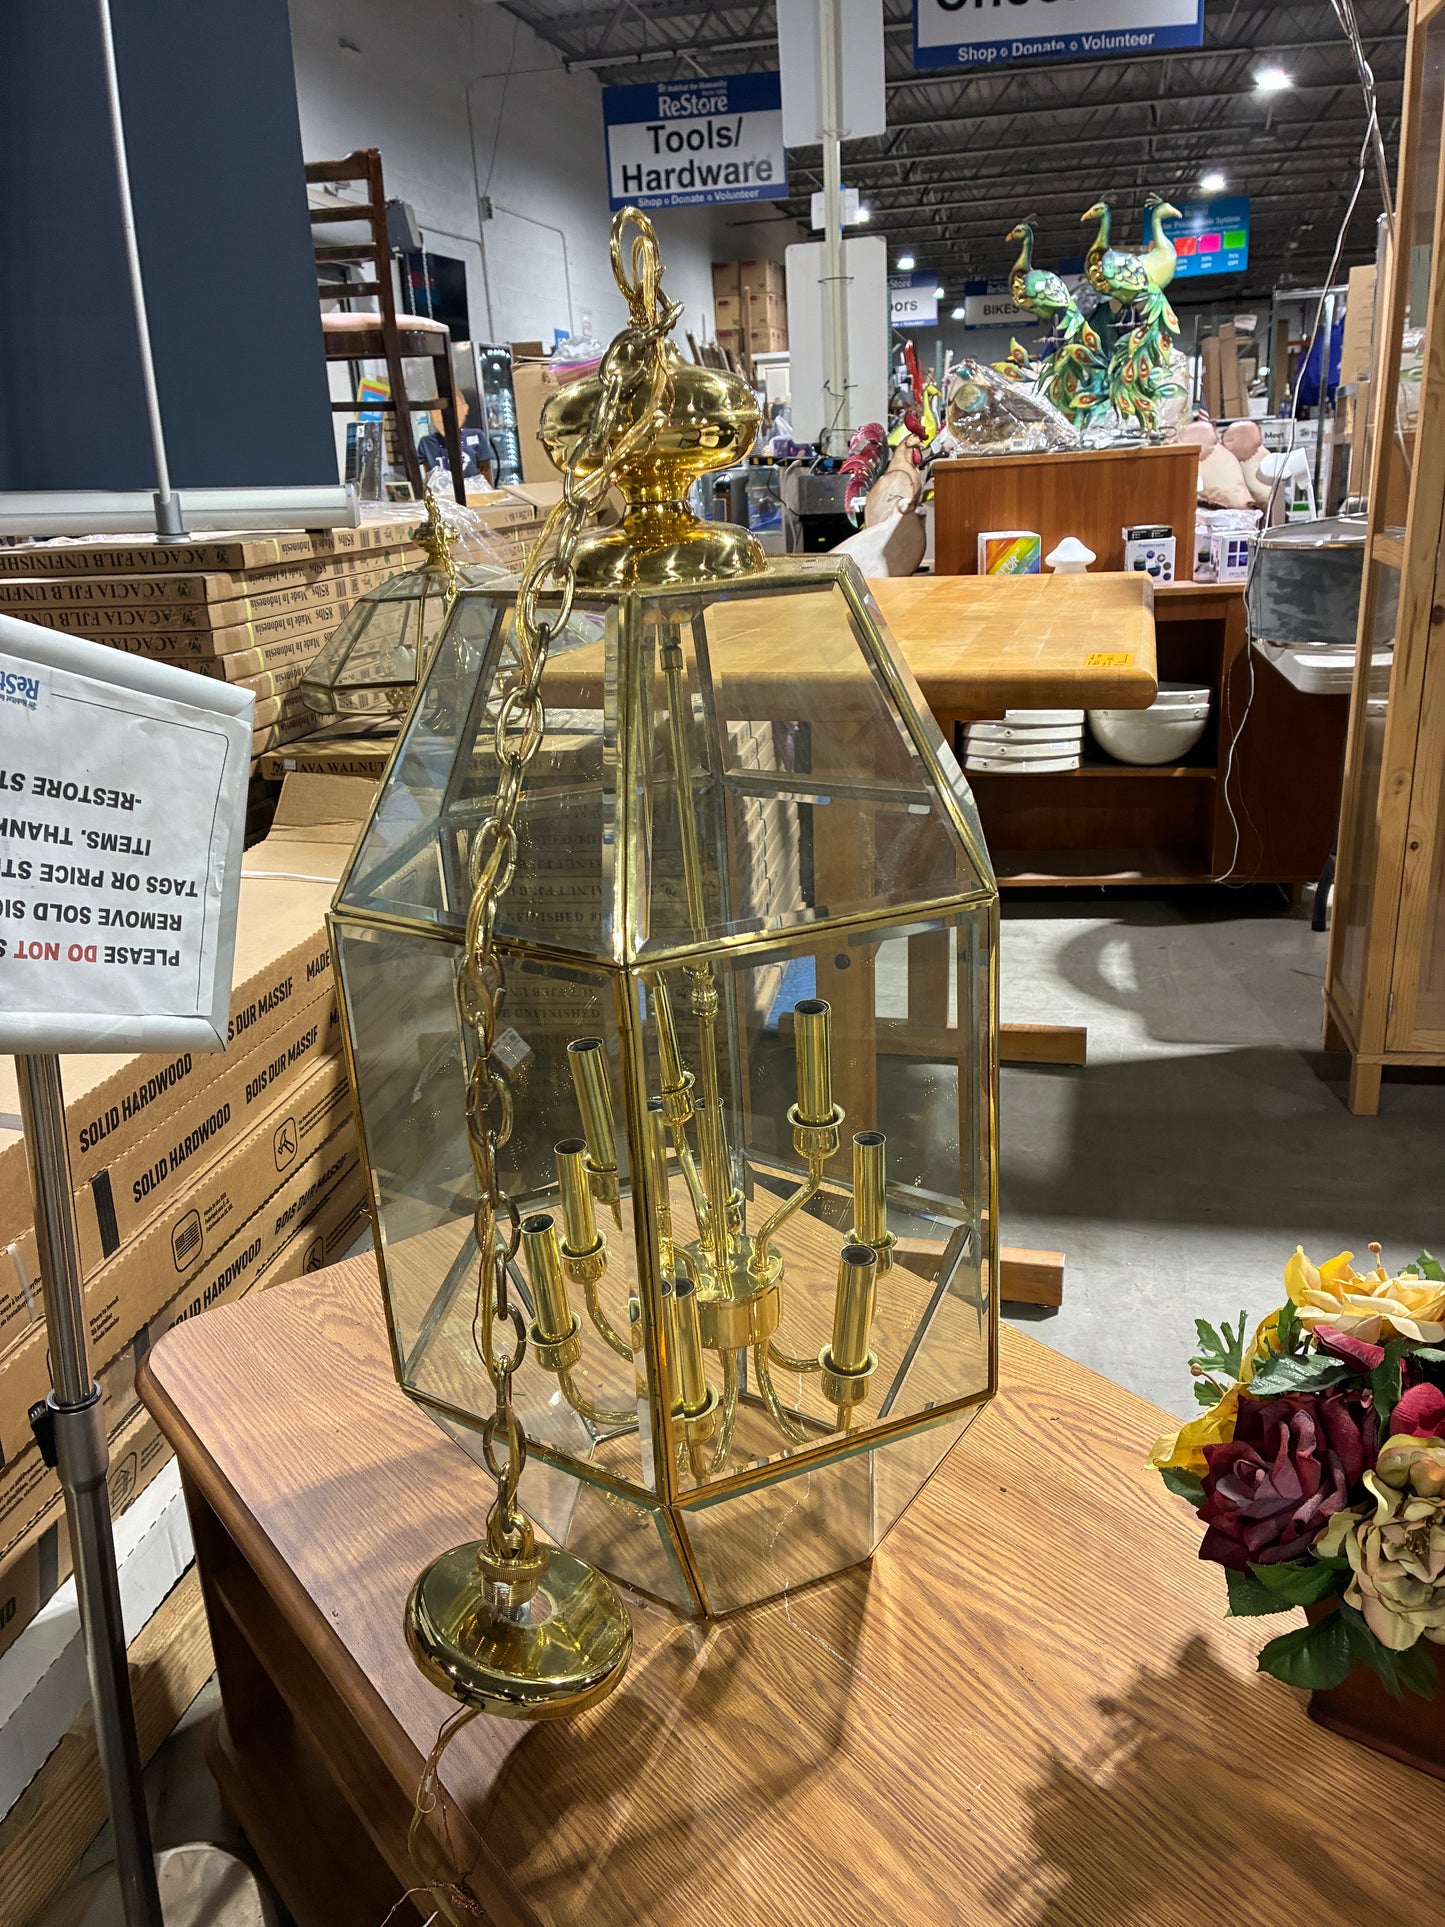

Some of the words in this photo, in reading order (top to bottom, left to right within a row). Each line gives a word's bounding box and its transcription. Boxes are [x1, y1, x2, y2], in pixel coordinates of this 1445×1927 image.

[958, 46, 996, 62] Shop
[1012, 39, 1065, 57] Donate
[1081, 32, 1155, 50] Volunteer
[659, 94, 728, 117] ReStore
[646, 116, 743, 154] Tools/
[622, 158, 773, 193] Hardware
[637, 196, 662, 208] Shop
[671, 193, 705, 205] Donate
[714, 189, 759, 201] Volunteer
[983, 303, 1020, 316] BIKES
[93, 551, 135, 568] FJLB
[137, 549, 207, 566] ACACIA
[51, 584, 94, 600] FJLB
[96, 582, 168, 599] ACACIA
[59, 611, 100, 627] FJLB
[104, 609, 172, 625] ACACIA
[254, 619, 286, 636] Indonesia
[264, 644, 295, 661] Indonesia
[327, 761, 386, 774] WALNUT
[32, 776, 142, 811] -RESTORE
[81, 829, 152, 857] ITEMS.
[39, 863, 104, 888] PRICE
[111, 871, 140, 892] OR
[146, 876, 198, 898] TAGS
[33, 902, 92, 925] SOLD
[98, 908, 182, 932] REMOVE
[13, 940, 60, 961] NOT
[68, 944, 98, 963] DO
[104, 946, 180, 967] PLEASE
[235, 1004, 257, 1035] DUR
[258, 976, 293, 1018] MASSIF
[306, 949, 331, 982] MADE
[79, 1106, 119, 1153] SOLID
[122, 1052, 193, 1123] HARDWOOD
[133, 1164, 168, 1203] SOLID
[170, 1103, 231, 1171] HARDWOOD
[245, 1073, 268, 1105] BOIS
[268, 1055, 287, 1084] DUR
[287, 1025, 318, 1066] MASSIF
[203, 1237, 262, 1310] HARDWOOD
[275, 1208, 296, 1236] BOIS
